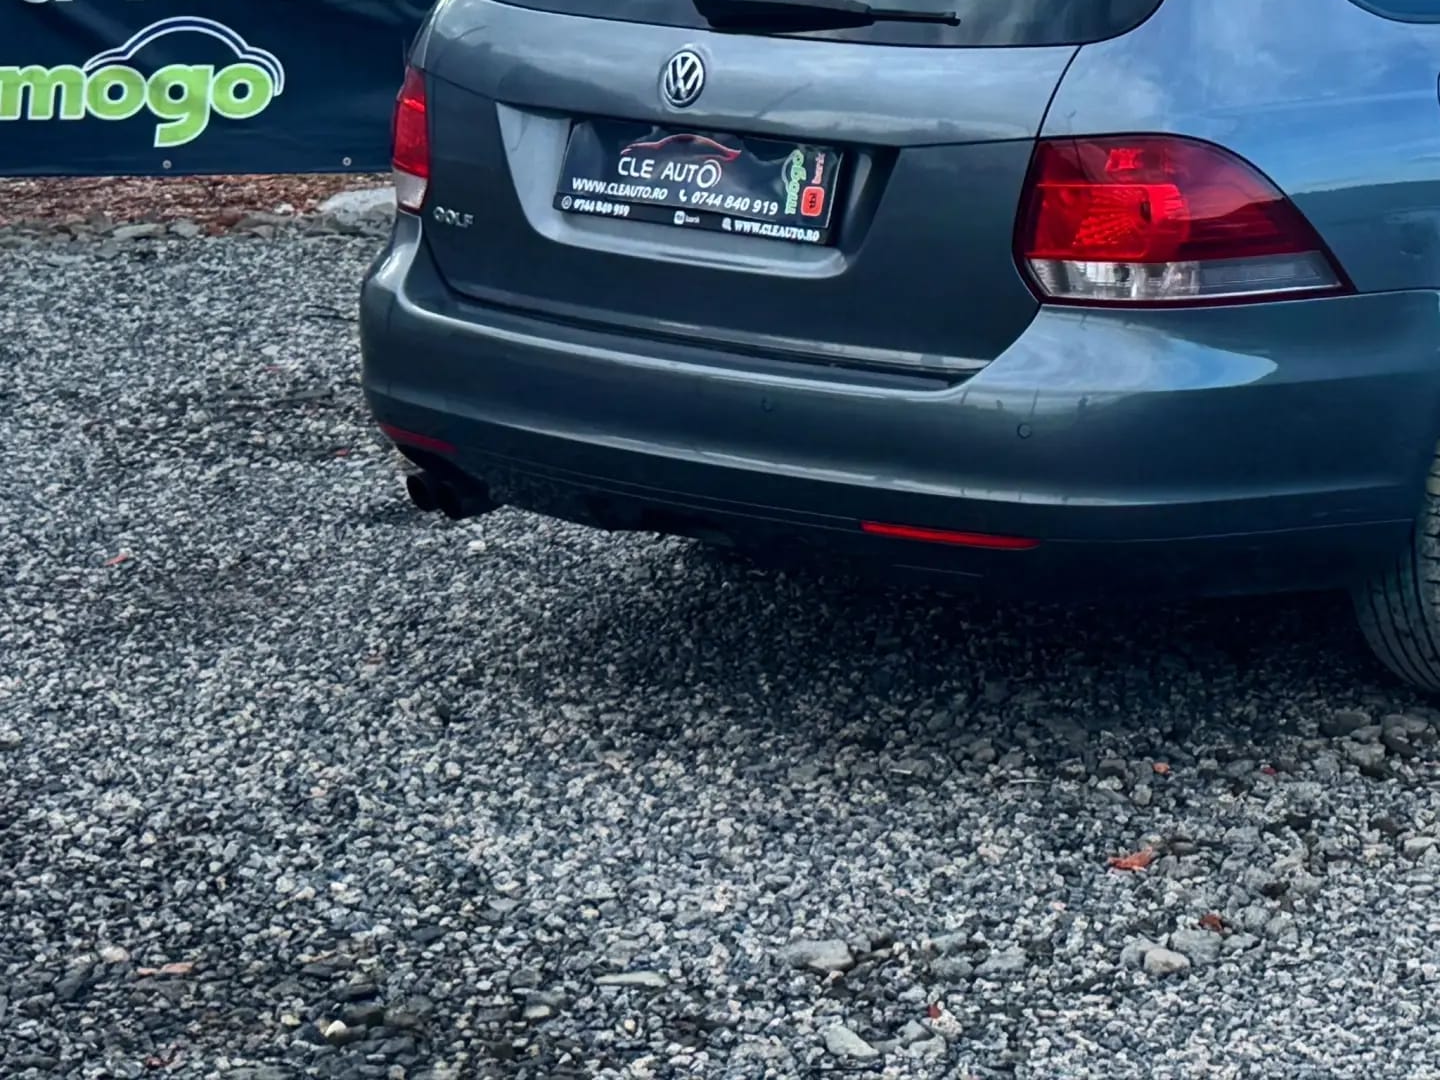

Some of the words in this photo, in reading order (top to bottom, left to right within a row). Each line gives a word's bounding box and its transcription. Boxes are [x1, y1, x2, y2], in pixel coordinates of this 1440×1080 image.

[0, 63, 274, 148] mogo
[618, 157, 655, 178] CLE
[660, 160, 718, 189] AUTO
[784, 149, 807, 215] mogo
[572, 177, 668, 200] WWW.CLEAUTO.RO
[691, 191, 723, 207] 0744
[724, 195, 750, 211] 840
[752, 198, 778, 215] 919
[734, 220, 820, 241] WWW.CLEAUTO.RO
